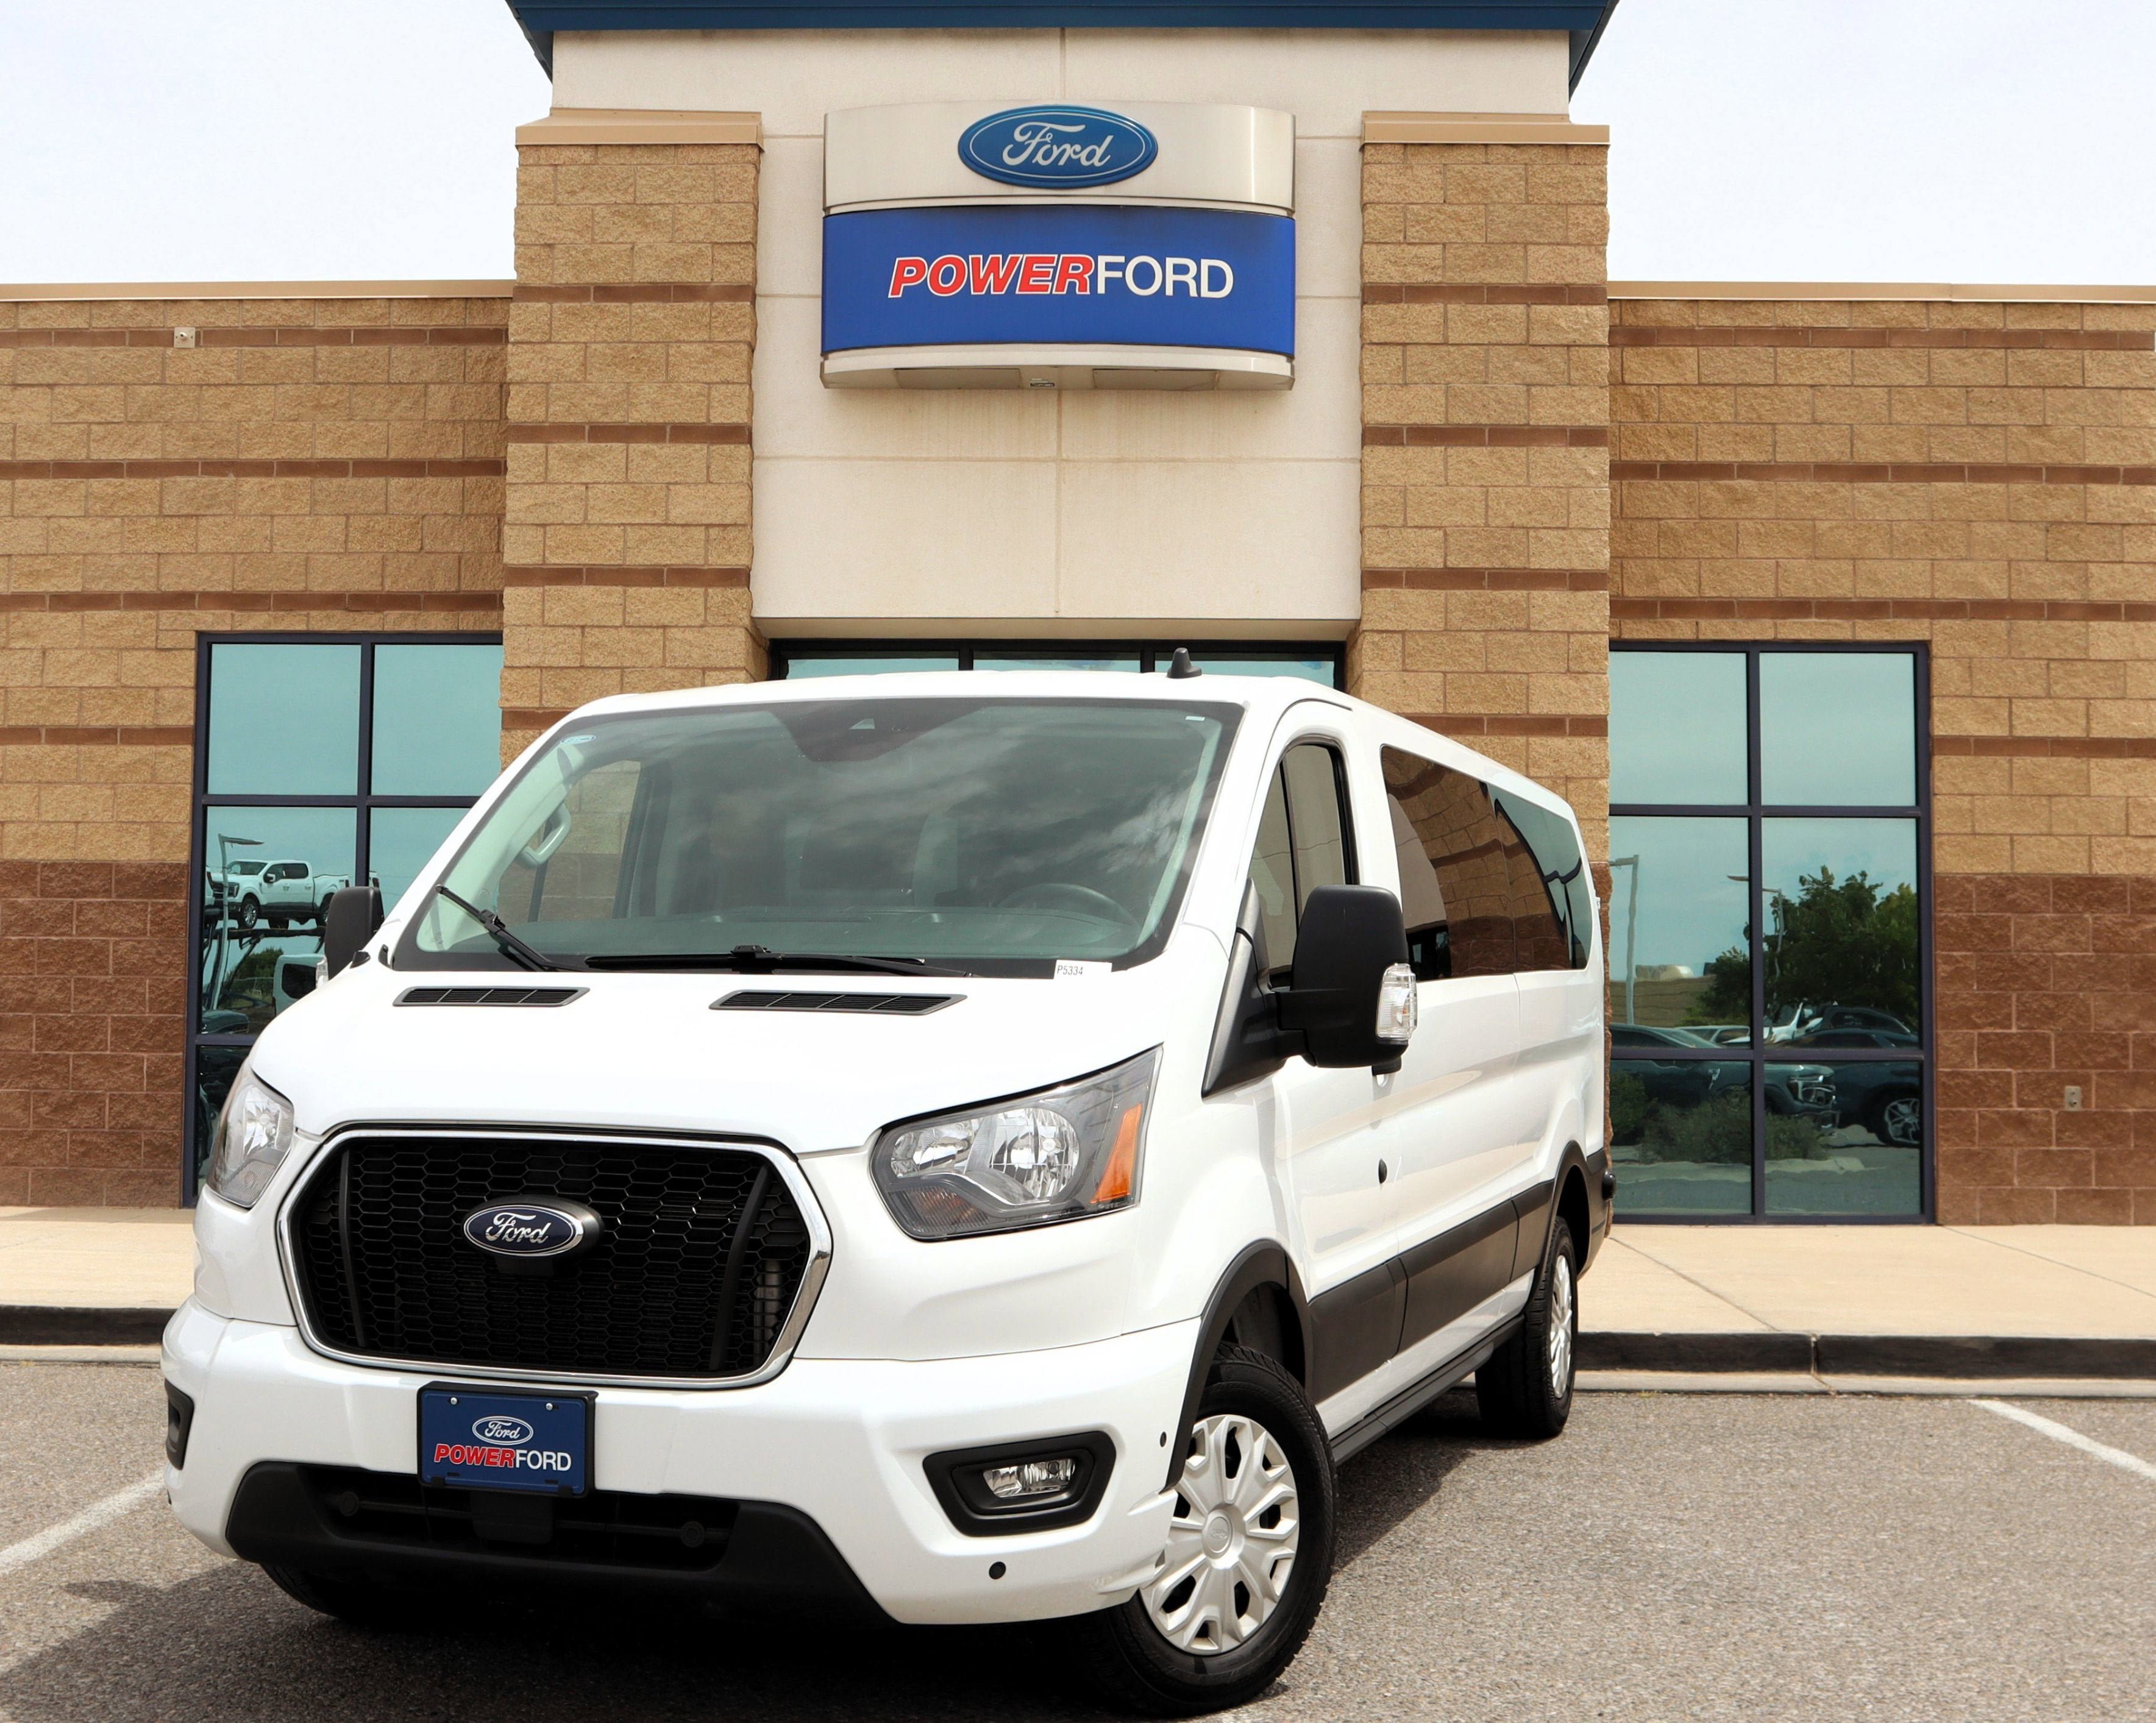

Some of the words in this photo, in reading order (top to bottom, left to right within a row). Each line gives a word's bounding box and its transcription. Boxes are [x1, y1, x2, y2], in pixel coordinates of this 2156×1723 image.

[1002, 121, 1114, 167] Ford
[1057, 965, 1083, 976] P5334
[485, 1212, 552, 1243] Ford
[485, 1421, 521, 1439] Ford
